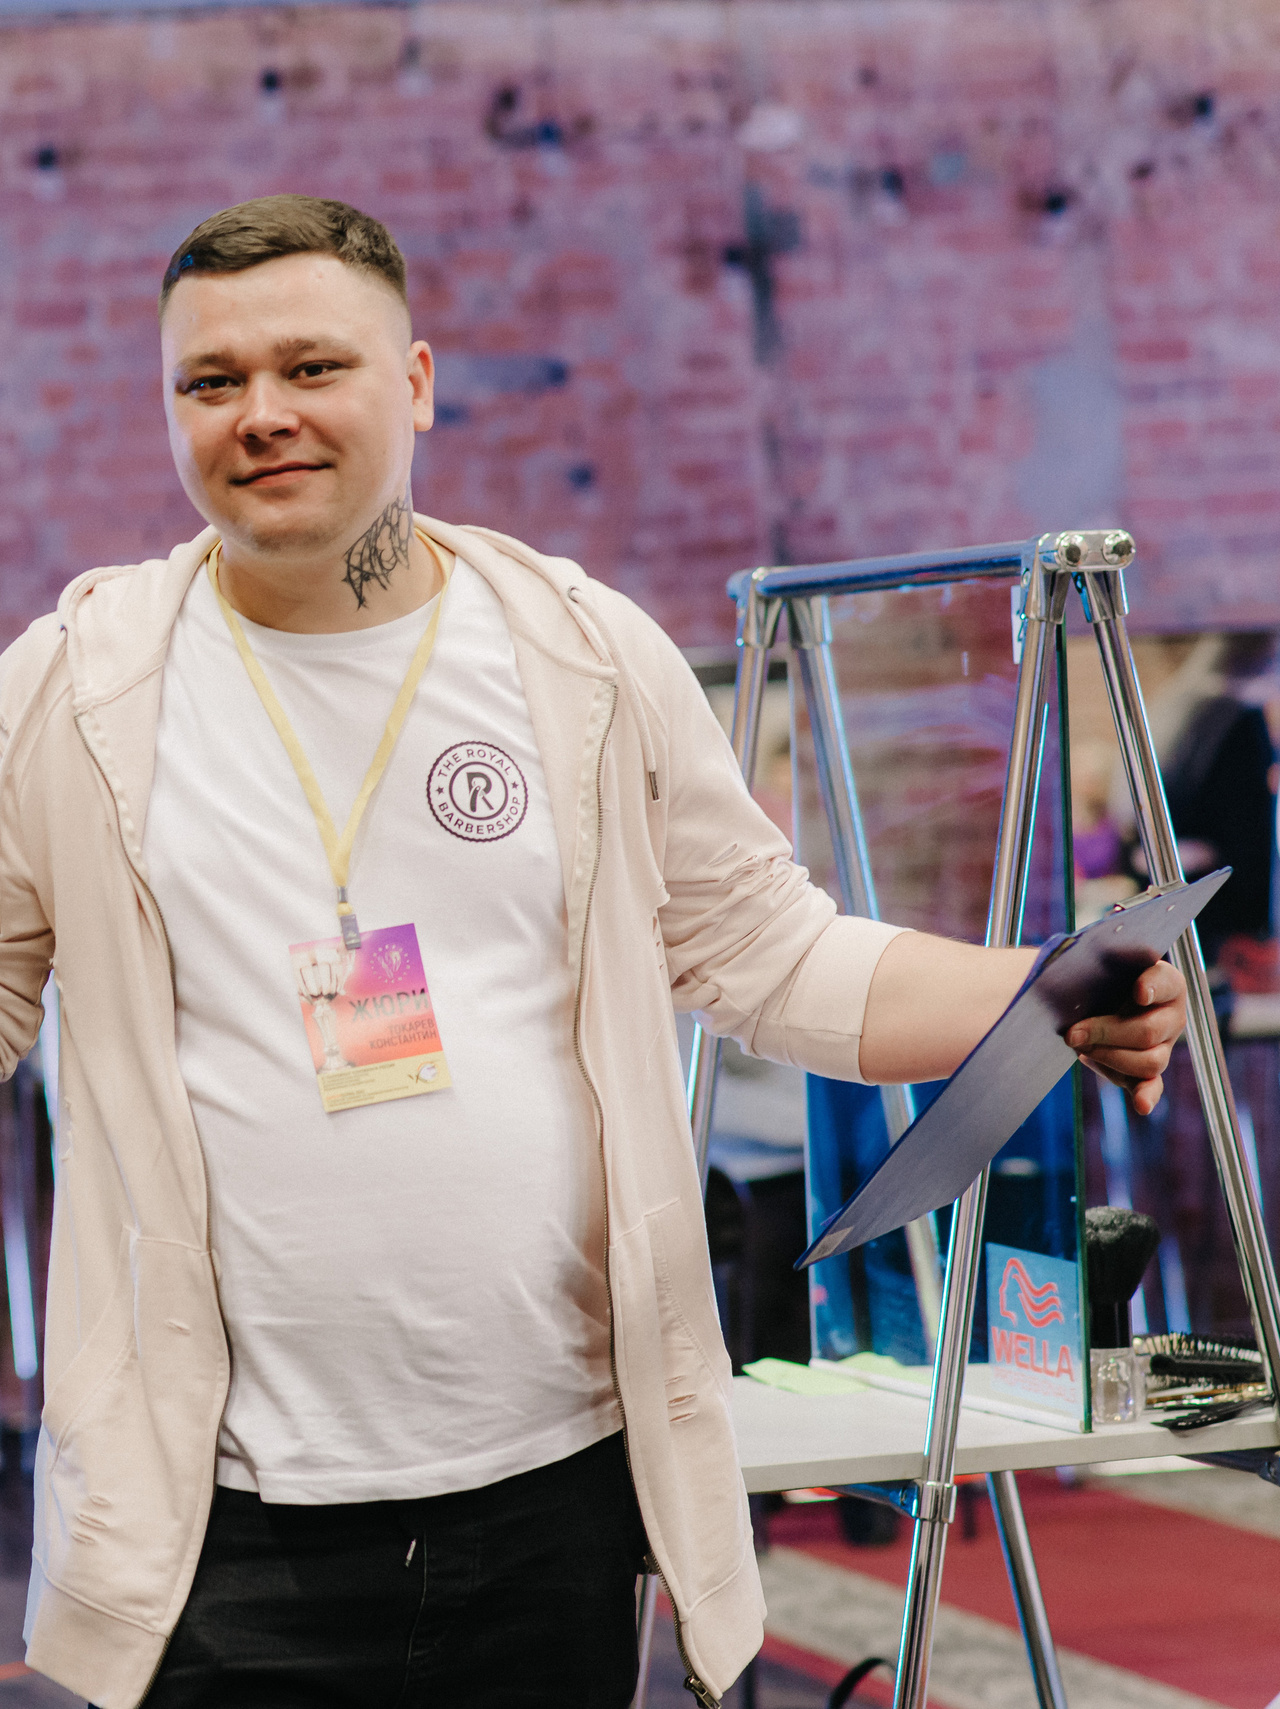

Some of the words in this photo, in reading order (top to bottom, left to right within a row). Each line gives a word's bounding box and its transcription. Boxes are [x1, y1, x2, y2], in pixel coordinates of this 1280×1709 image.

[438, 753, 462, 777] THE
[467, 749, 510, 775] ROYAL
[438, 797, 520, 834] BARBERSHOP
[349, 988, 429, 1022] ЖЮРИ
[370, 1031, 437, 1049] КОНСТАНТИН
[388, 1019, 434, 1036] ТОКАРЕВ
[991, 1326, 1075, 1382] WELLA
